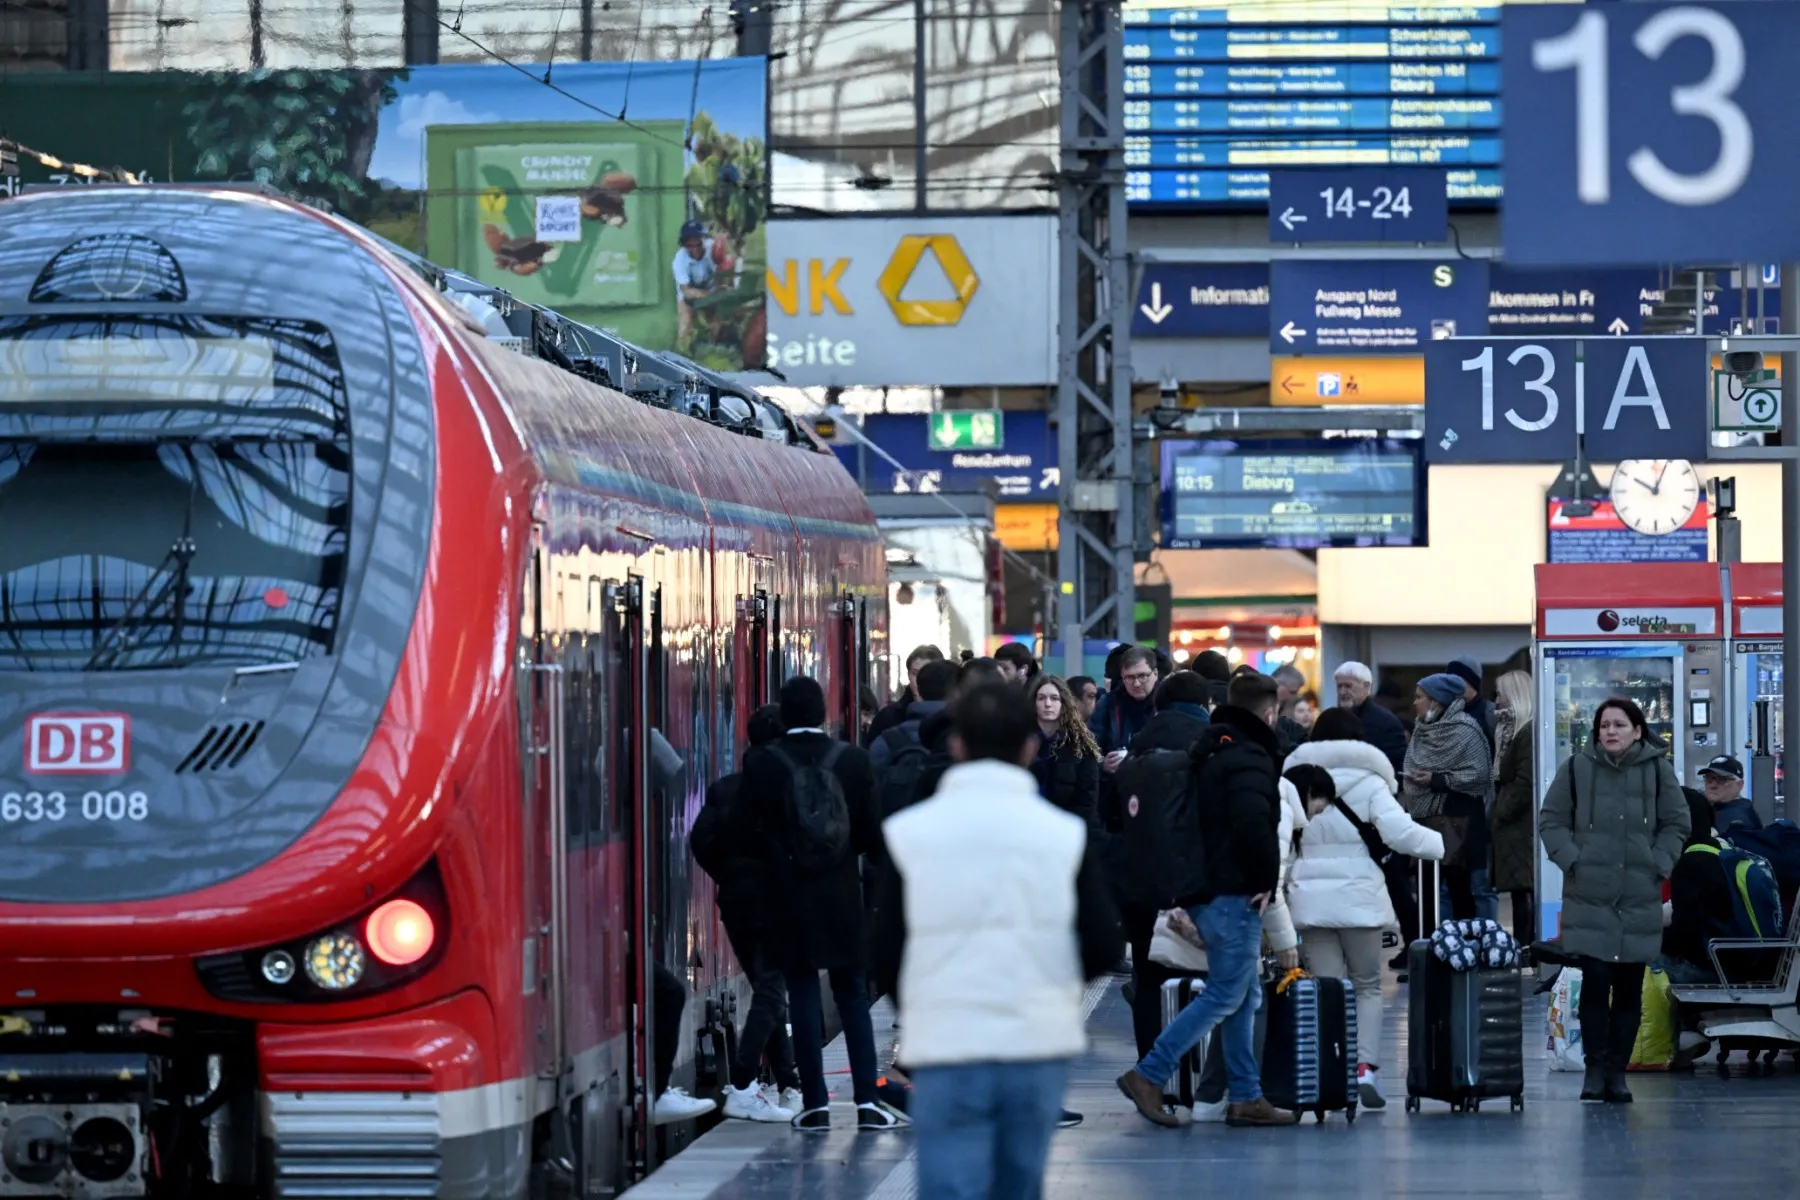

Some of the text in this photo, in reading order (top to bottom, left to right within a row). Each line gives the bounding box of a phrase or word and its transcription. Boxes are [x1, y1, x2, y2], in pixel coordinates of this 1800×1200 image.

[1532, 6, 1754, 206] 13
[1320, 186, 1413, 219] 14-24
[1433, 265, 1453, 287] S
[1315, 289, 1397, 304] Ausgang Nord
[1363, 304, 1401, 318] Messe
[1462, 345, 1671, 431] 13 A
[38, 723, 116, 764] DB
[1, 790, 149, 822] 633 008
